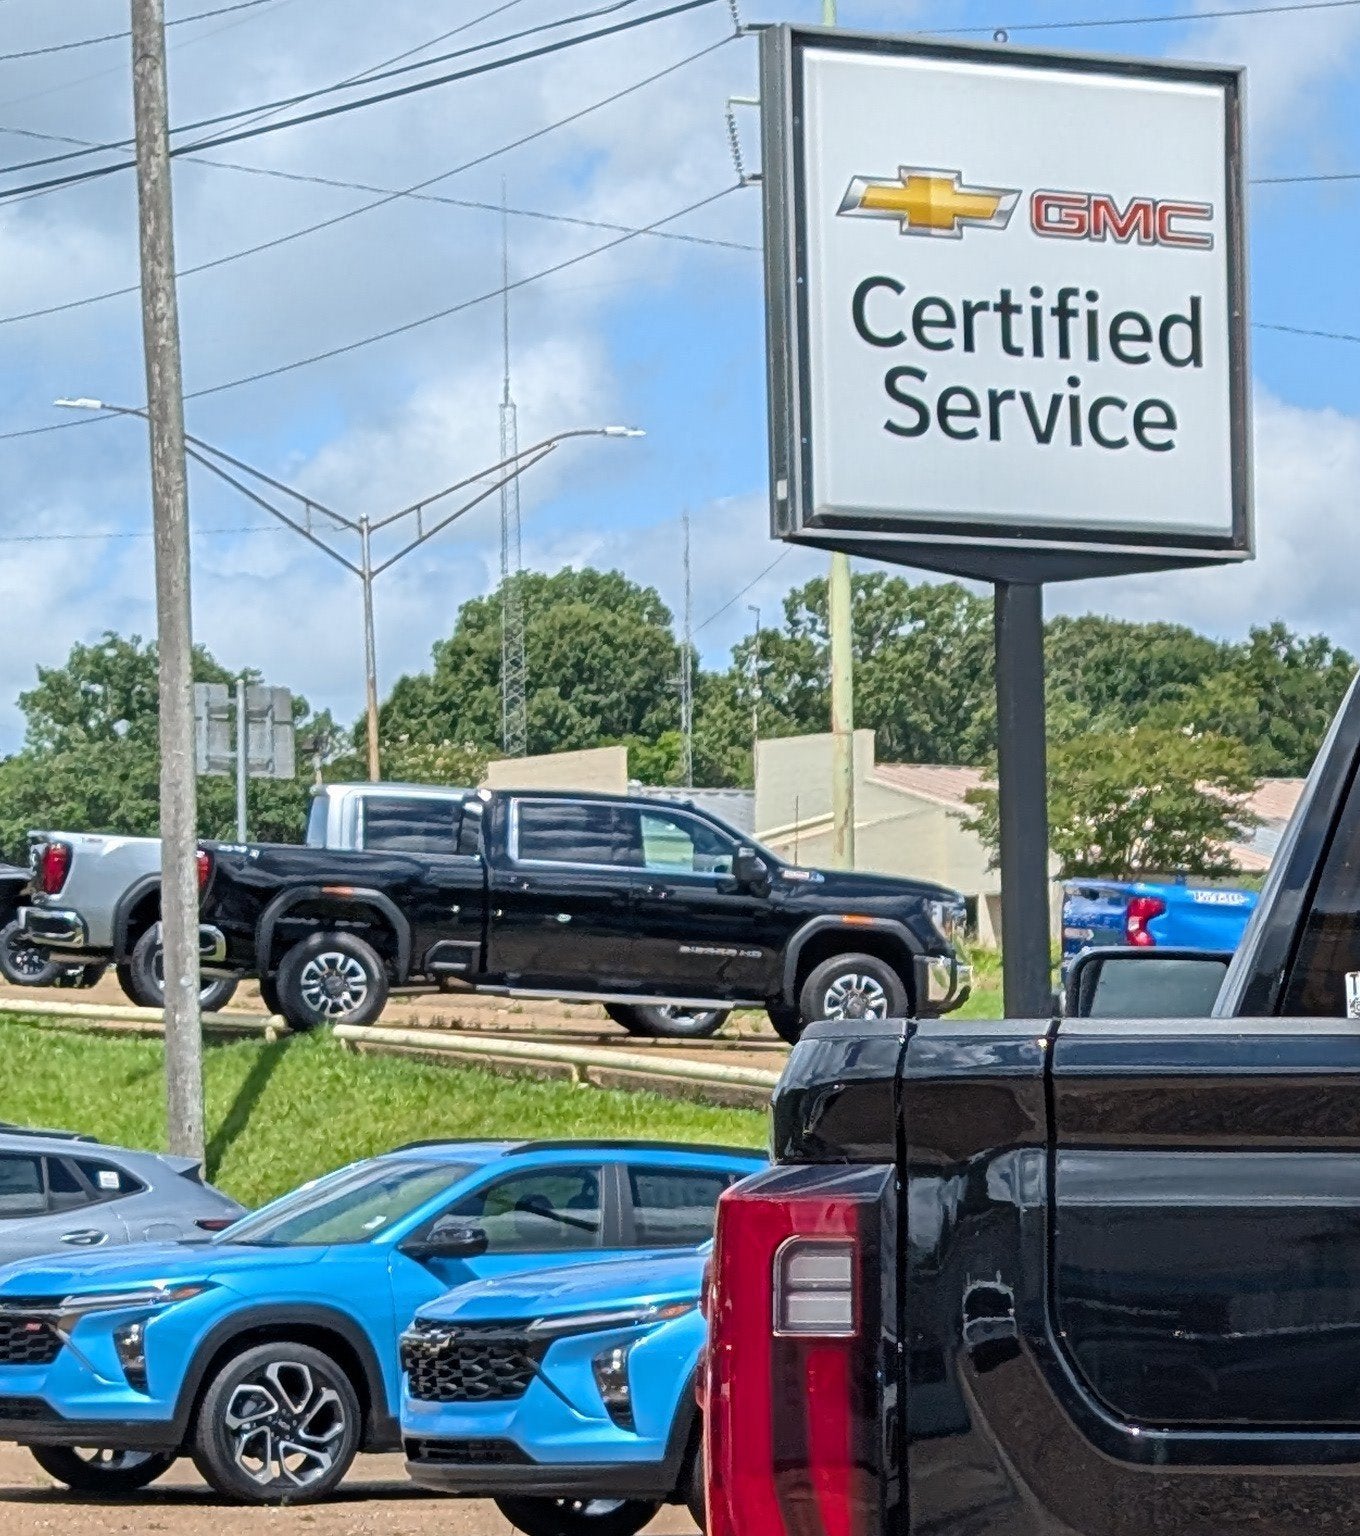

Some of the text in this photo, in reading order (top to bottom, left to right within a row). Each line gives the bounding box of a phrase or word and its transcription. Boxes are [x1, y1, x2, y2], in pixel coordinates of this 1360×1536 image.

[1029, 189, 1214, 251] GMC
[851, 275, 1203, 368] Certified
[883, 365, 1178, 452] Service
